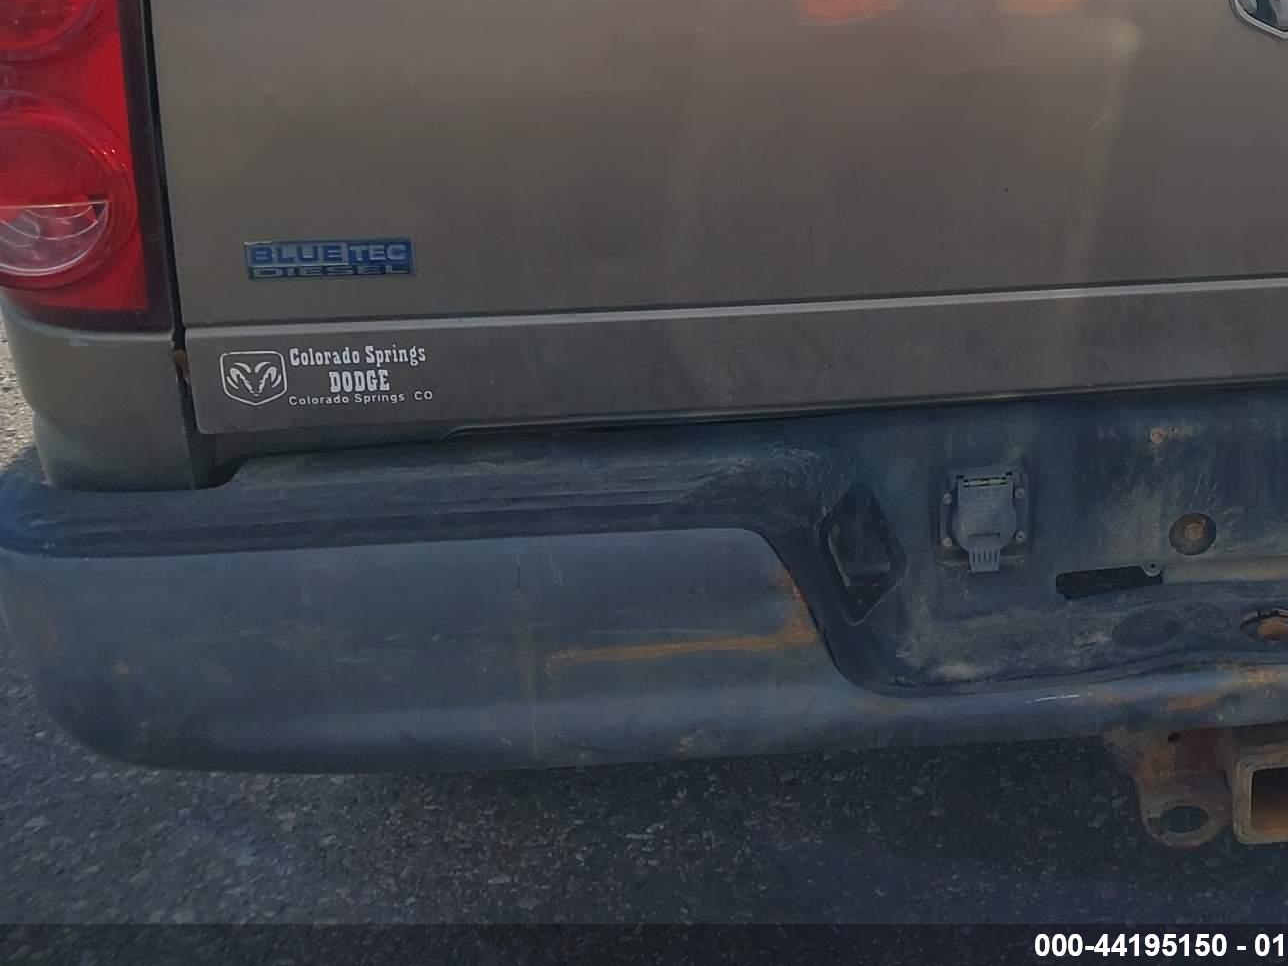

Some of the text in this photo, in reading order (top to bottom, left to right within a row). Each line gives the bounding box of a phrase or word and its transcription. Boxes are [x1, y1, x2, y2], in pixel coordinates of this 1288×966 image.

[253, 265, 408, 278] DIESEL
[289, 344, 426, 367] Colorado Springs
[328, 370, 390, 393] DODGE
[288, 390, 434, 406] Colorado Springs CO
